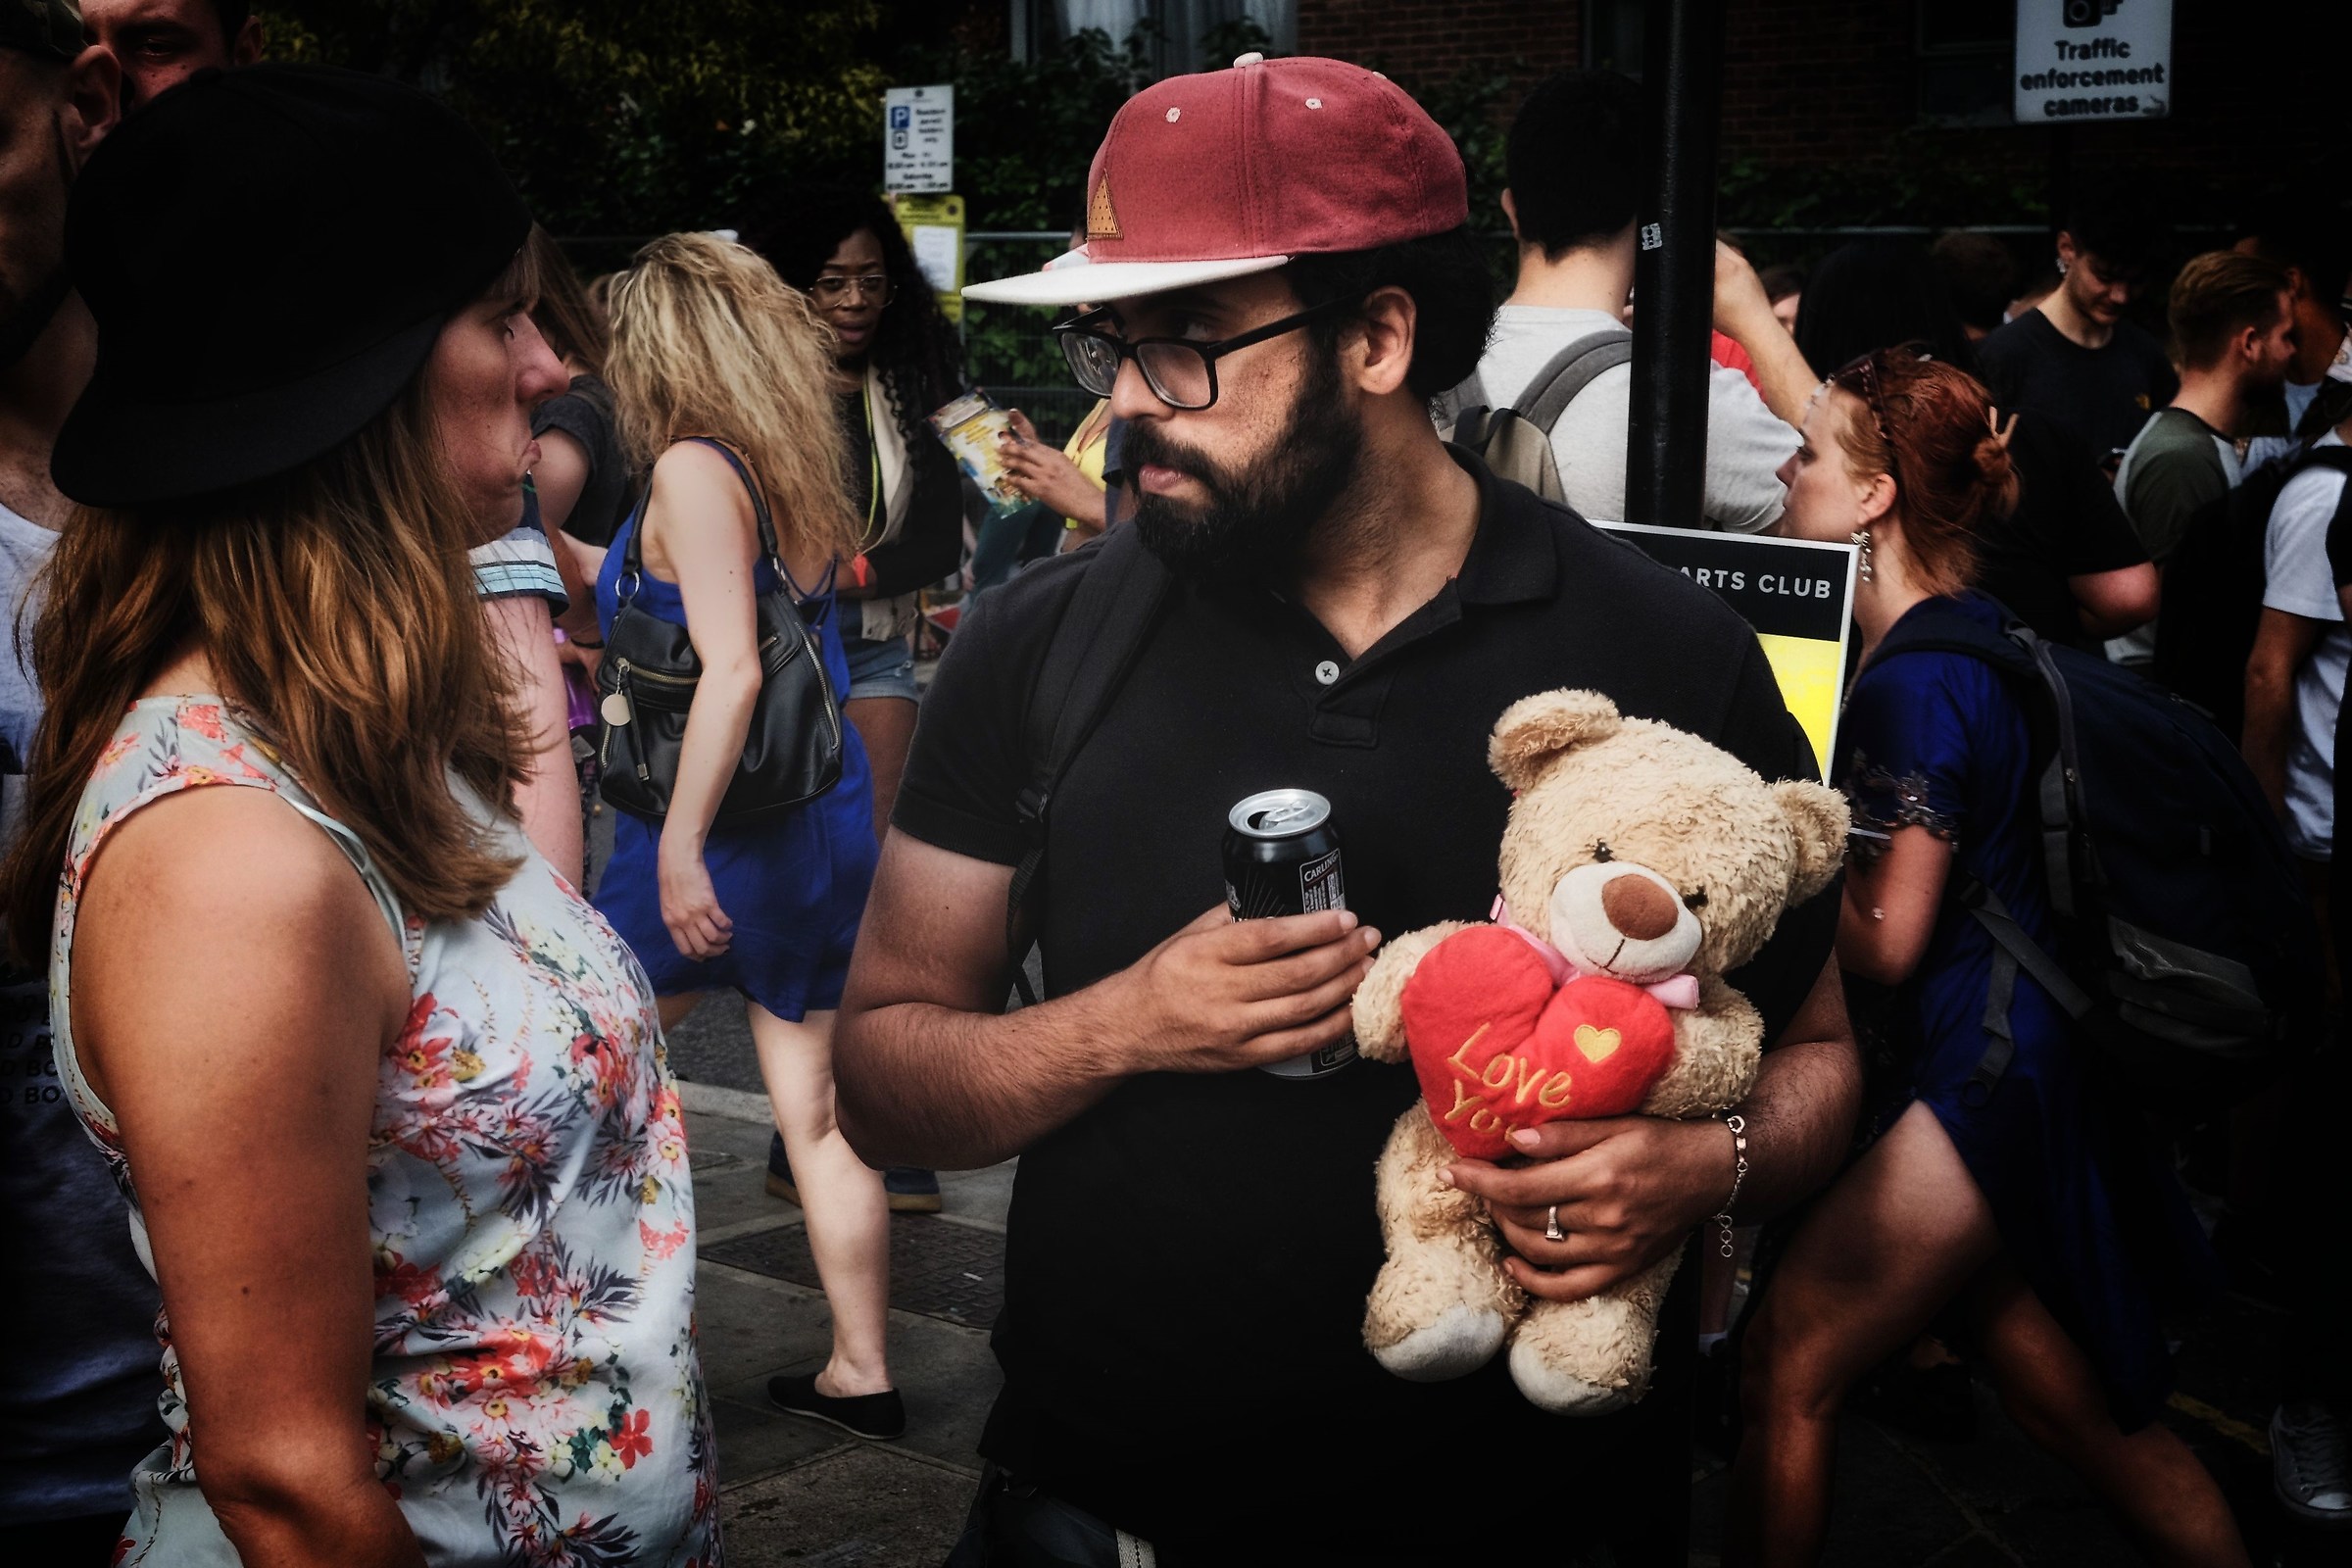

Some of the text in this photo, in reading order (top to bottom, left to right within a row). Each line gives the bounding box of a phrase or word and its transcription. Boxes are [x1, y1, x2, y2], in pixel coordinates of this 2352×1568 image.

[2054, 37, 2131, 61] Traffic
[2020, 62, 2165, 90] enforcement
[2043, 95, 2139, 117] cameras
[1757, 573, 1832, 599] CLUB
[1304, 853, 1337, 882] CARLING
[1447, 1021, 1573, 1109] Love
